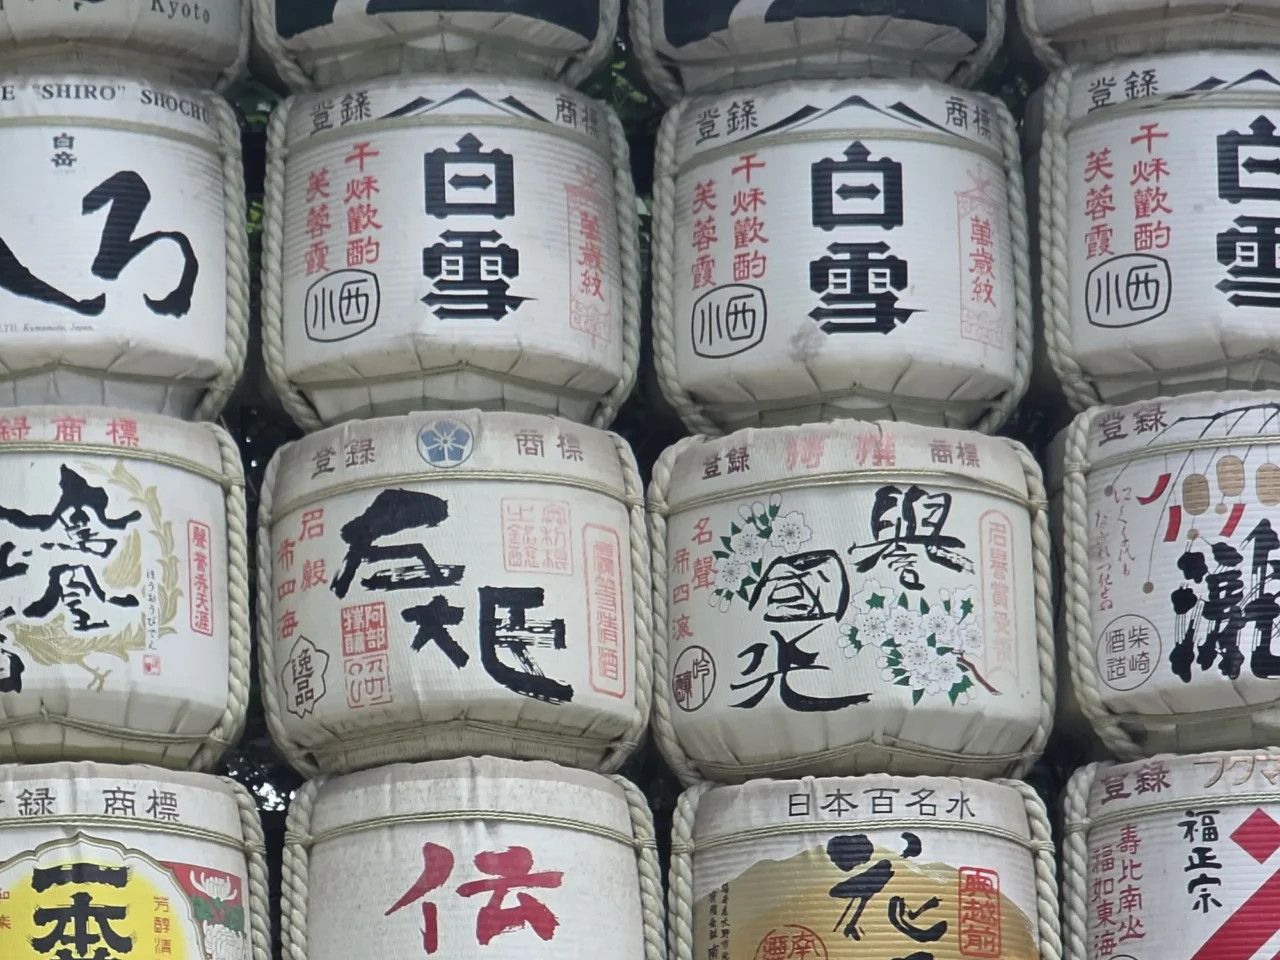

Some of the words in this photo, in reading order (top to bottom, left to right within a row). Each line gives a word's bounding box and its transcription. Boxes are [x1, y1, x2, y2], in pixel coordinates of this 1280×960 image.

[554, 93, 601, 139] 商標
[944, 96, 994, 141] 商標
[420, 132, 539, 322] 白雪
[808, 140, 929, 336] 白雪
[292, 647, 315, 707] 逸品
[101, 787, 180, 822] 商標
[787, 787, 976, 820] 日本百名水
[1177, 810, 1223, 914] 福正宗
